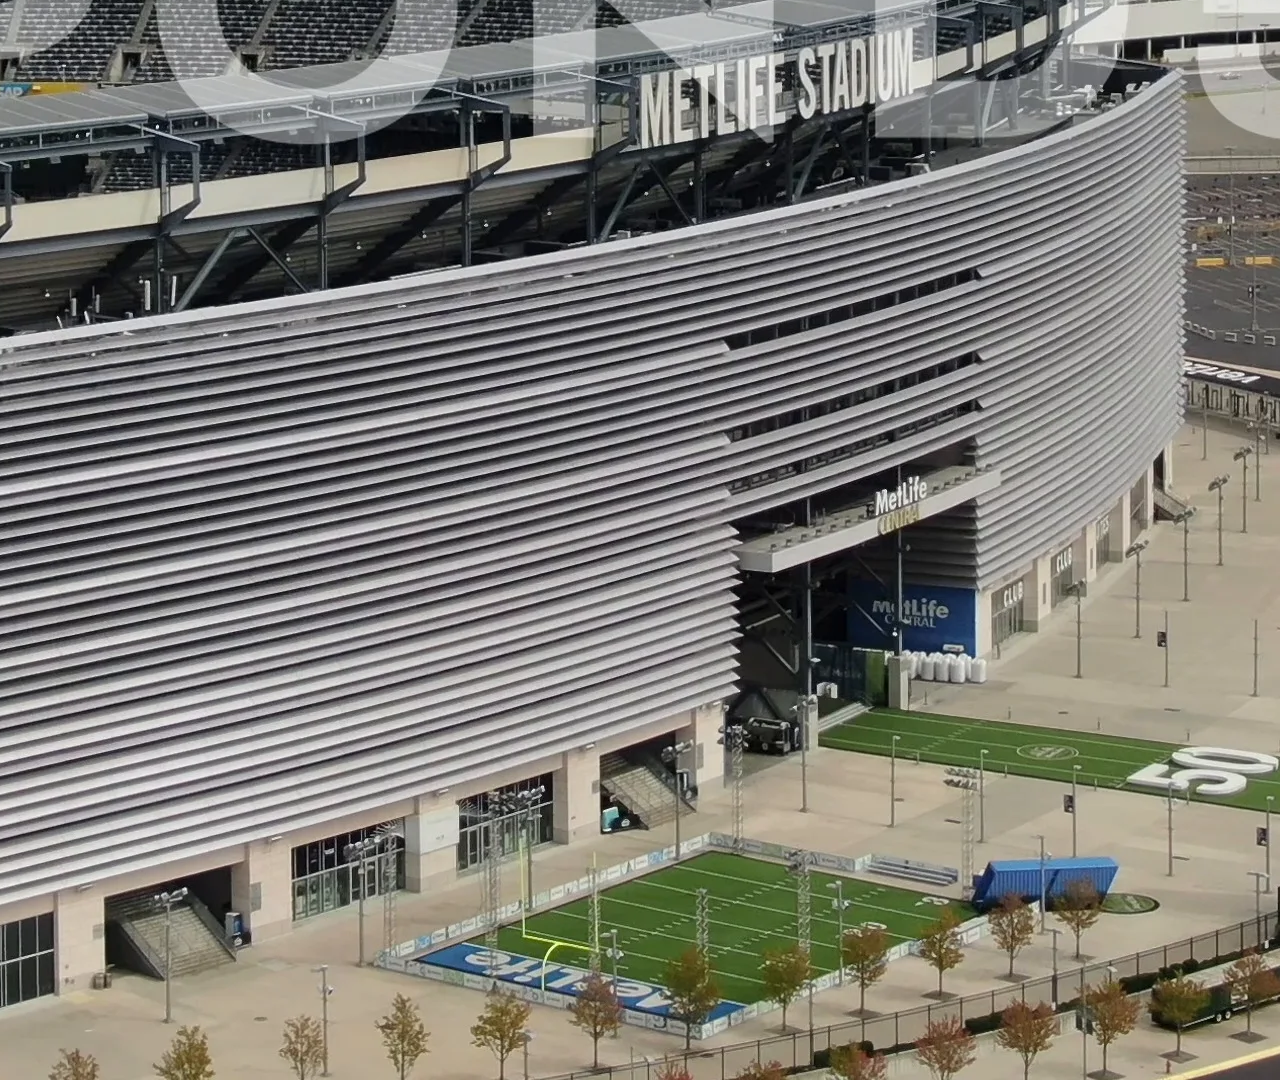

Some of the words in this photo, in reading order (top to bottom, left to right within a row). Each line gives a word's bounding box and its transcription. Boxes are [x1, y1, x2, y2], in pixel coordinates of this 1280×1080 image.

[640, 53, 787, 149] METLIFE
[796, 26, 914, 120] STADIUM
[1182, 361, 1261, 384] veriz
[875, 475, 927, 516] MetLife
[877, 506, 921, 536] CENTRAL
[1056, 547, 1072, 573] CLUB
[872, 598, 949, 618] MtLife
[1003, 581, 1024, 608] CLUB
[1126, 746, 1280, 796] 50
